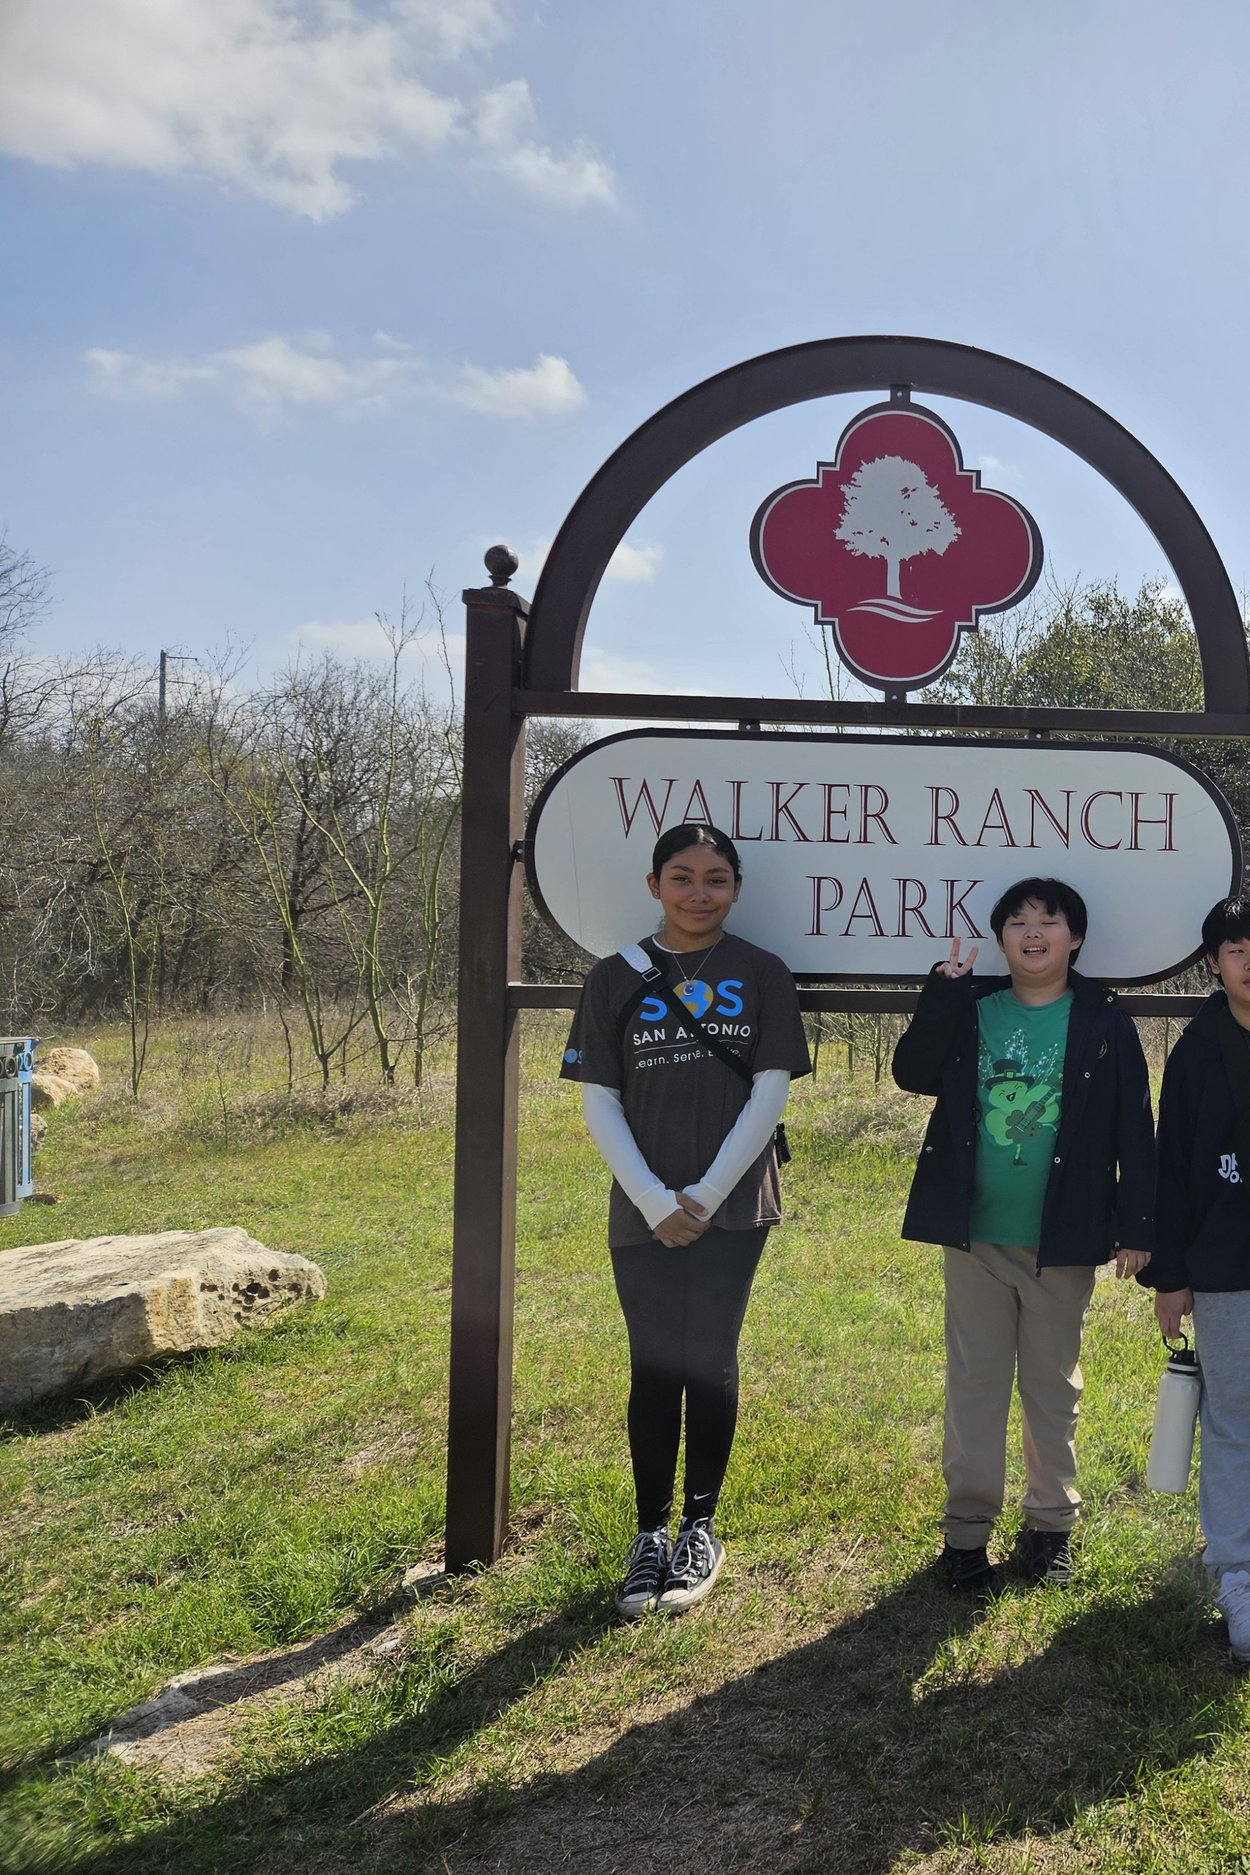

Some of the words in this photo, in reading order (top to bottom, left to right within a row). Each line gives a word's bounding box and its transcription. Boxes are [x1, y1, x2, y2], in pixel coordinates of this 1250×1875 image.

[608, 776, 899, 846] WALKER
[923, 785, 1179, 853] RANCH
[804, 875, 989, 939] PARK
[633, 1028, 666, 1046] SAN
[675, 1022, 751, 1040] AONIO
[635, 1056, 670, 1070] earn.
